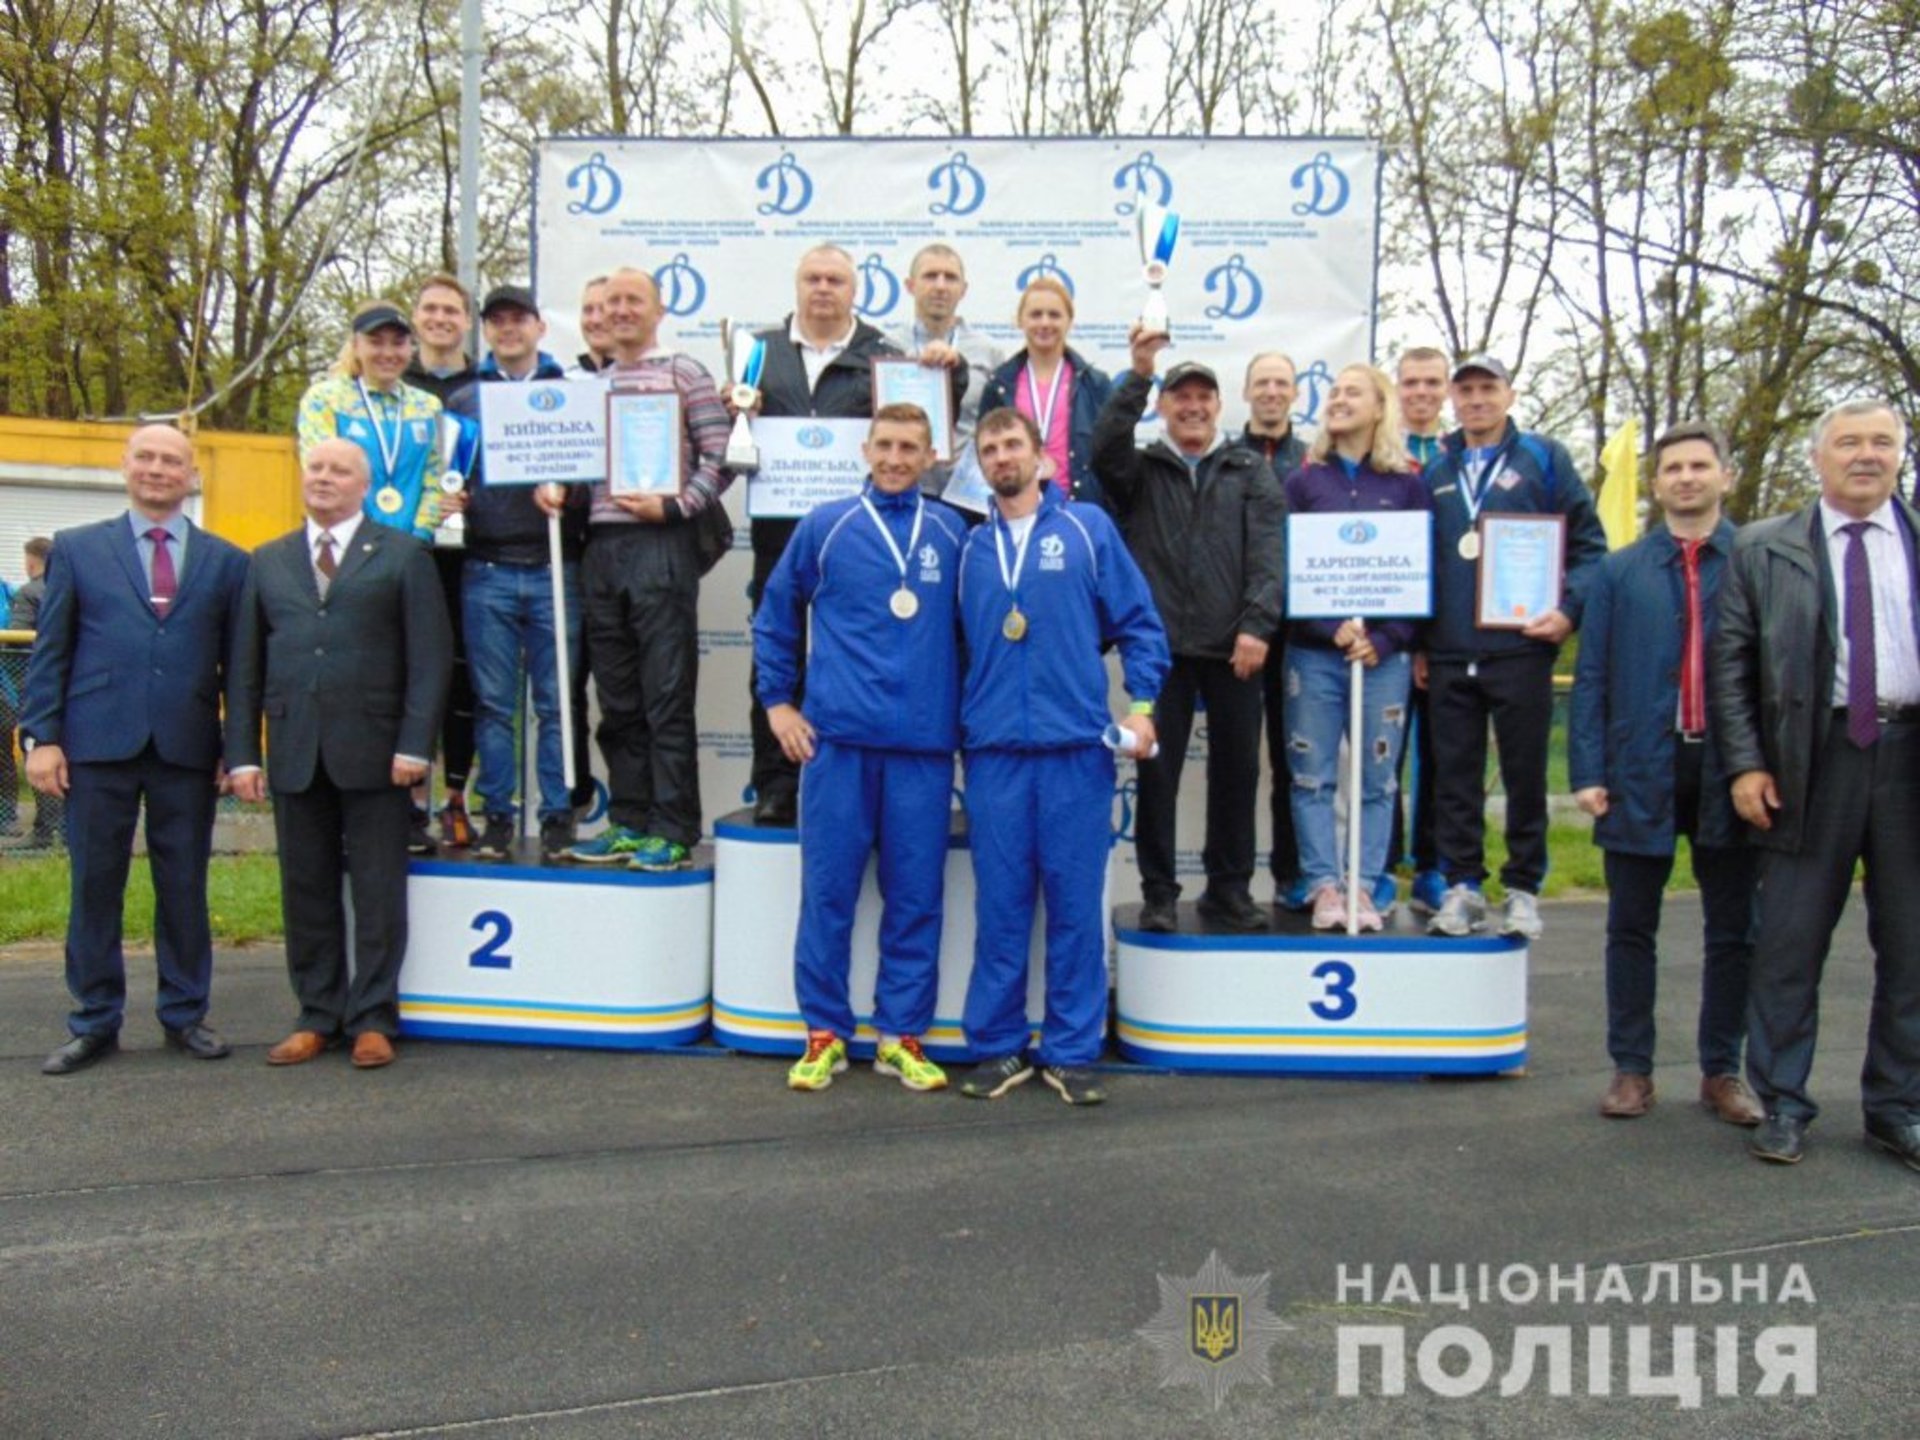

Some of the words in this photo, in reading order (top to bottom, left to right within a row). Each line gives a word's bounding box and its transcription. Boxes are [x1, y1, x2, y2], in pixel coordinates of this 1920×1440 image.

[504, 420, 595, 437] КИЇВСЬКА
[1305, 556, 1412, 569] ХАРКІВСЬКА
[469, 910, 513, 970] 2
[1308, 960, 1358, 1021] 3
